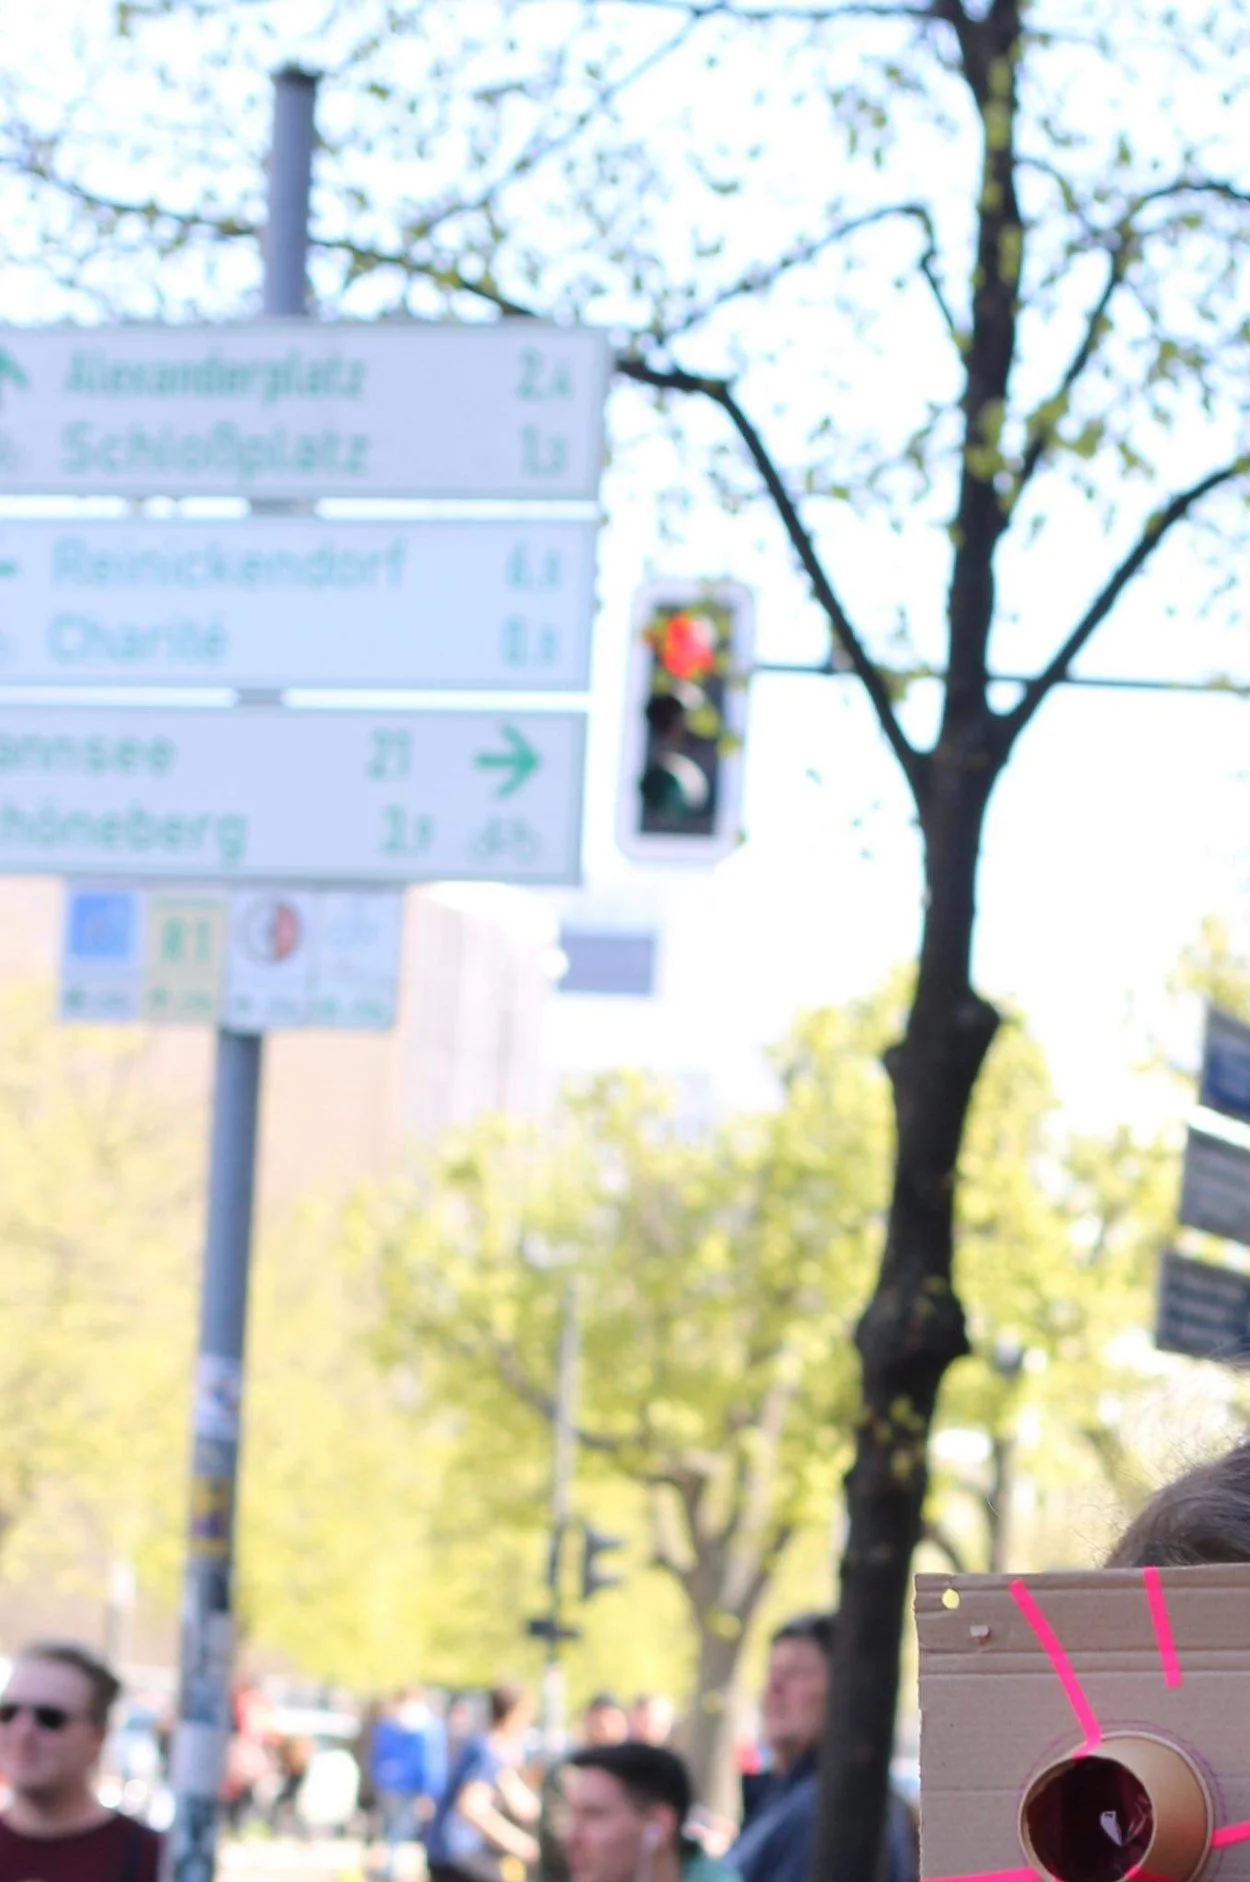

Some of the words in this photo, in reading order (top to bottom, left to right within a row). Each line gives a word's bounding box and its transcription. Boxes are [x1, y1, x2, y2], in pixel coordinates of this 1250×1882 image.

[65, 347, 366, 404] Alexanderplatz
[62, 421, 368, 482] Schloßplatz
[52, 537, 404, 589] Reinickendorf
